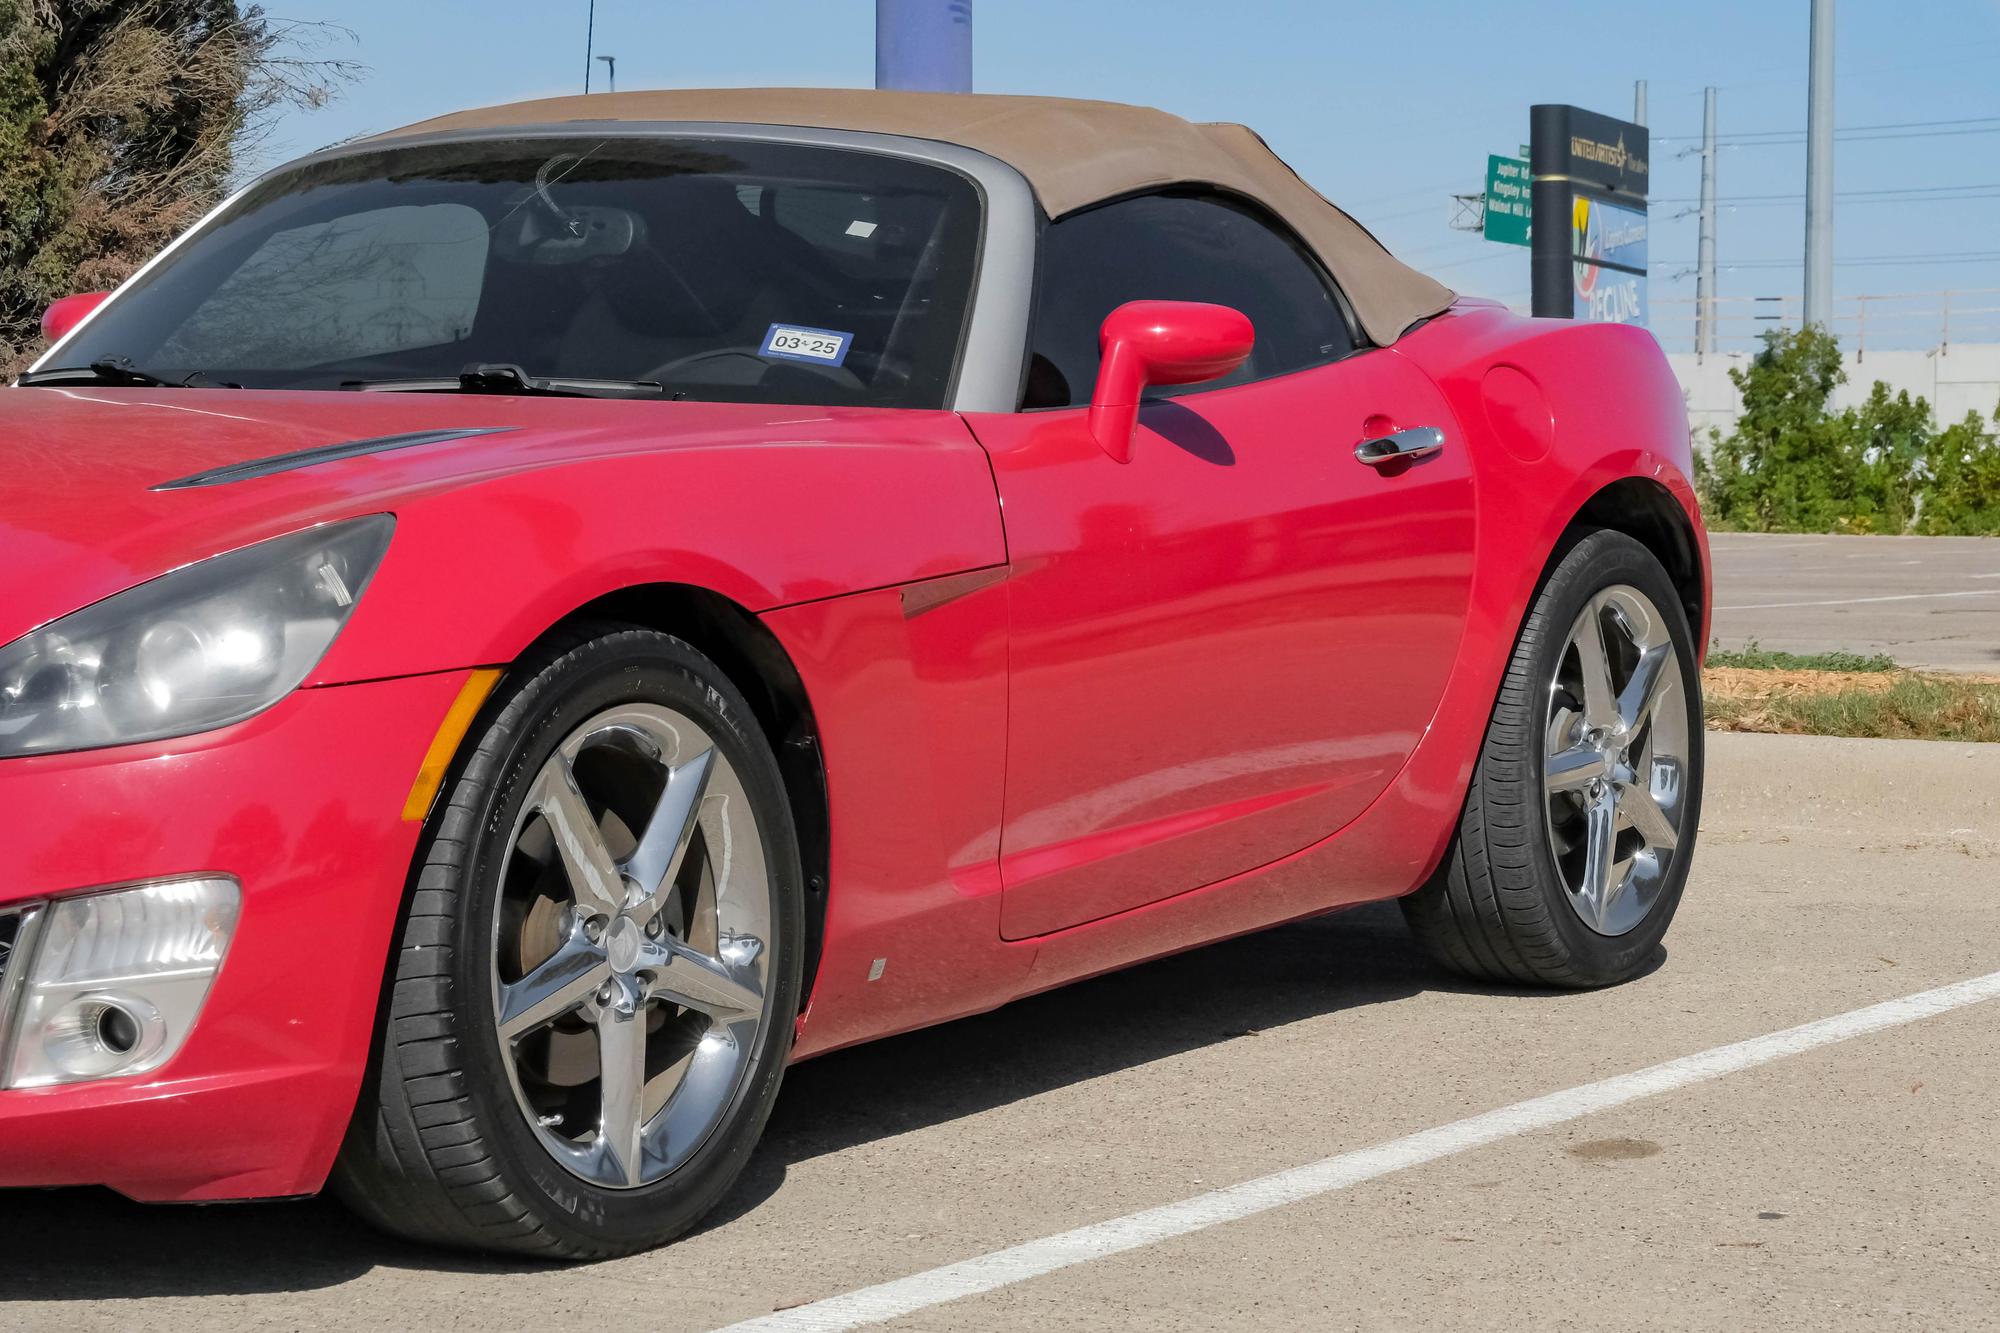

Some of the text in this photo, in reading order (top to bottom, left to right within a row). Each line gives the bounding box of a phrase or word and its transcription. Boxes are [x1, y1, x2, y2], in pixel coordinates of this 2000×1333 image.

[1571, 136, 1595, 160] UNITED
[1497, 162, 1530, 180] Jupiter Rd
[1493, 180, 1520, 200] Kingsley
[1489, 199, 1511, 214] Walnut
[1513, 203, 1524, 217] Hill
[775, 336, 800, 349] 03
[810, 340, 836, 354] 25
